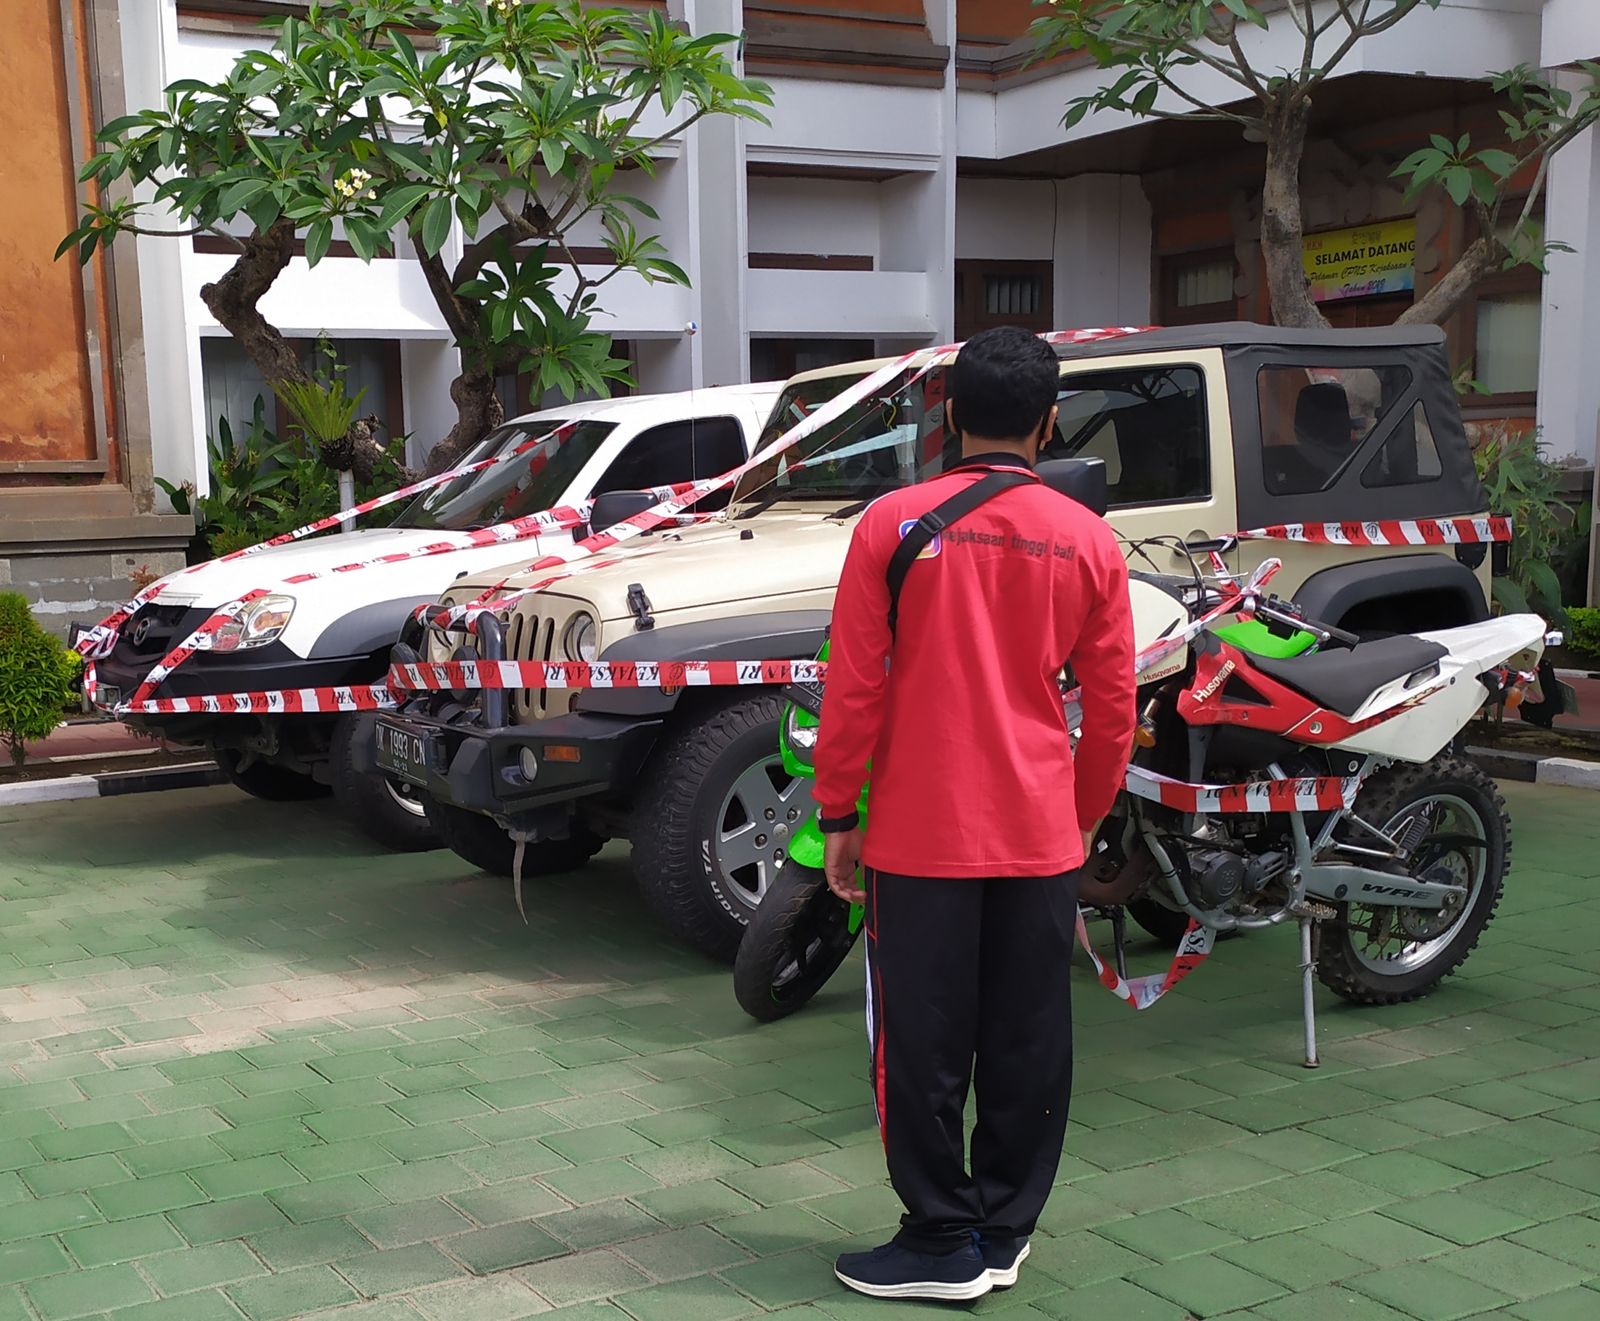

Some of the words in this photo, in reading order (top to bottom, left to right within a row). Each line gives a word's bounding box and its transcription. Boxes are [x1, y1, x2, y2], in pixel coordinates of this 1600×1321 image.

[1315, 248, 1365, 266] SELAMAT
[1368, 240, 1415, 258] DATANG
[1011, 534, 1048, 557] tinggi
[1053, 542, 1076, 561] bali
[543, 664, 563, 682] RI
[564, 664, 660, 682] KEJAKSAAN
[740, 664, 762, 681] RI
[1143, 664, 1181, 682] Husqvarna
[1192, 659, 1236, 703] Husqvarna
[390, 729, 409, 760] 1993
[413, 738, 426, 766] CN
[702, 840, 712, 876] T/A
[711, 881, 749, 926] rrain
[1362, 883, 1436, 900] WRE
